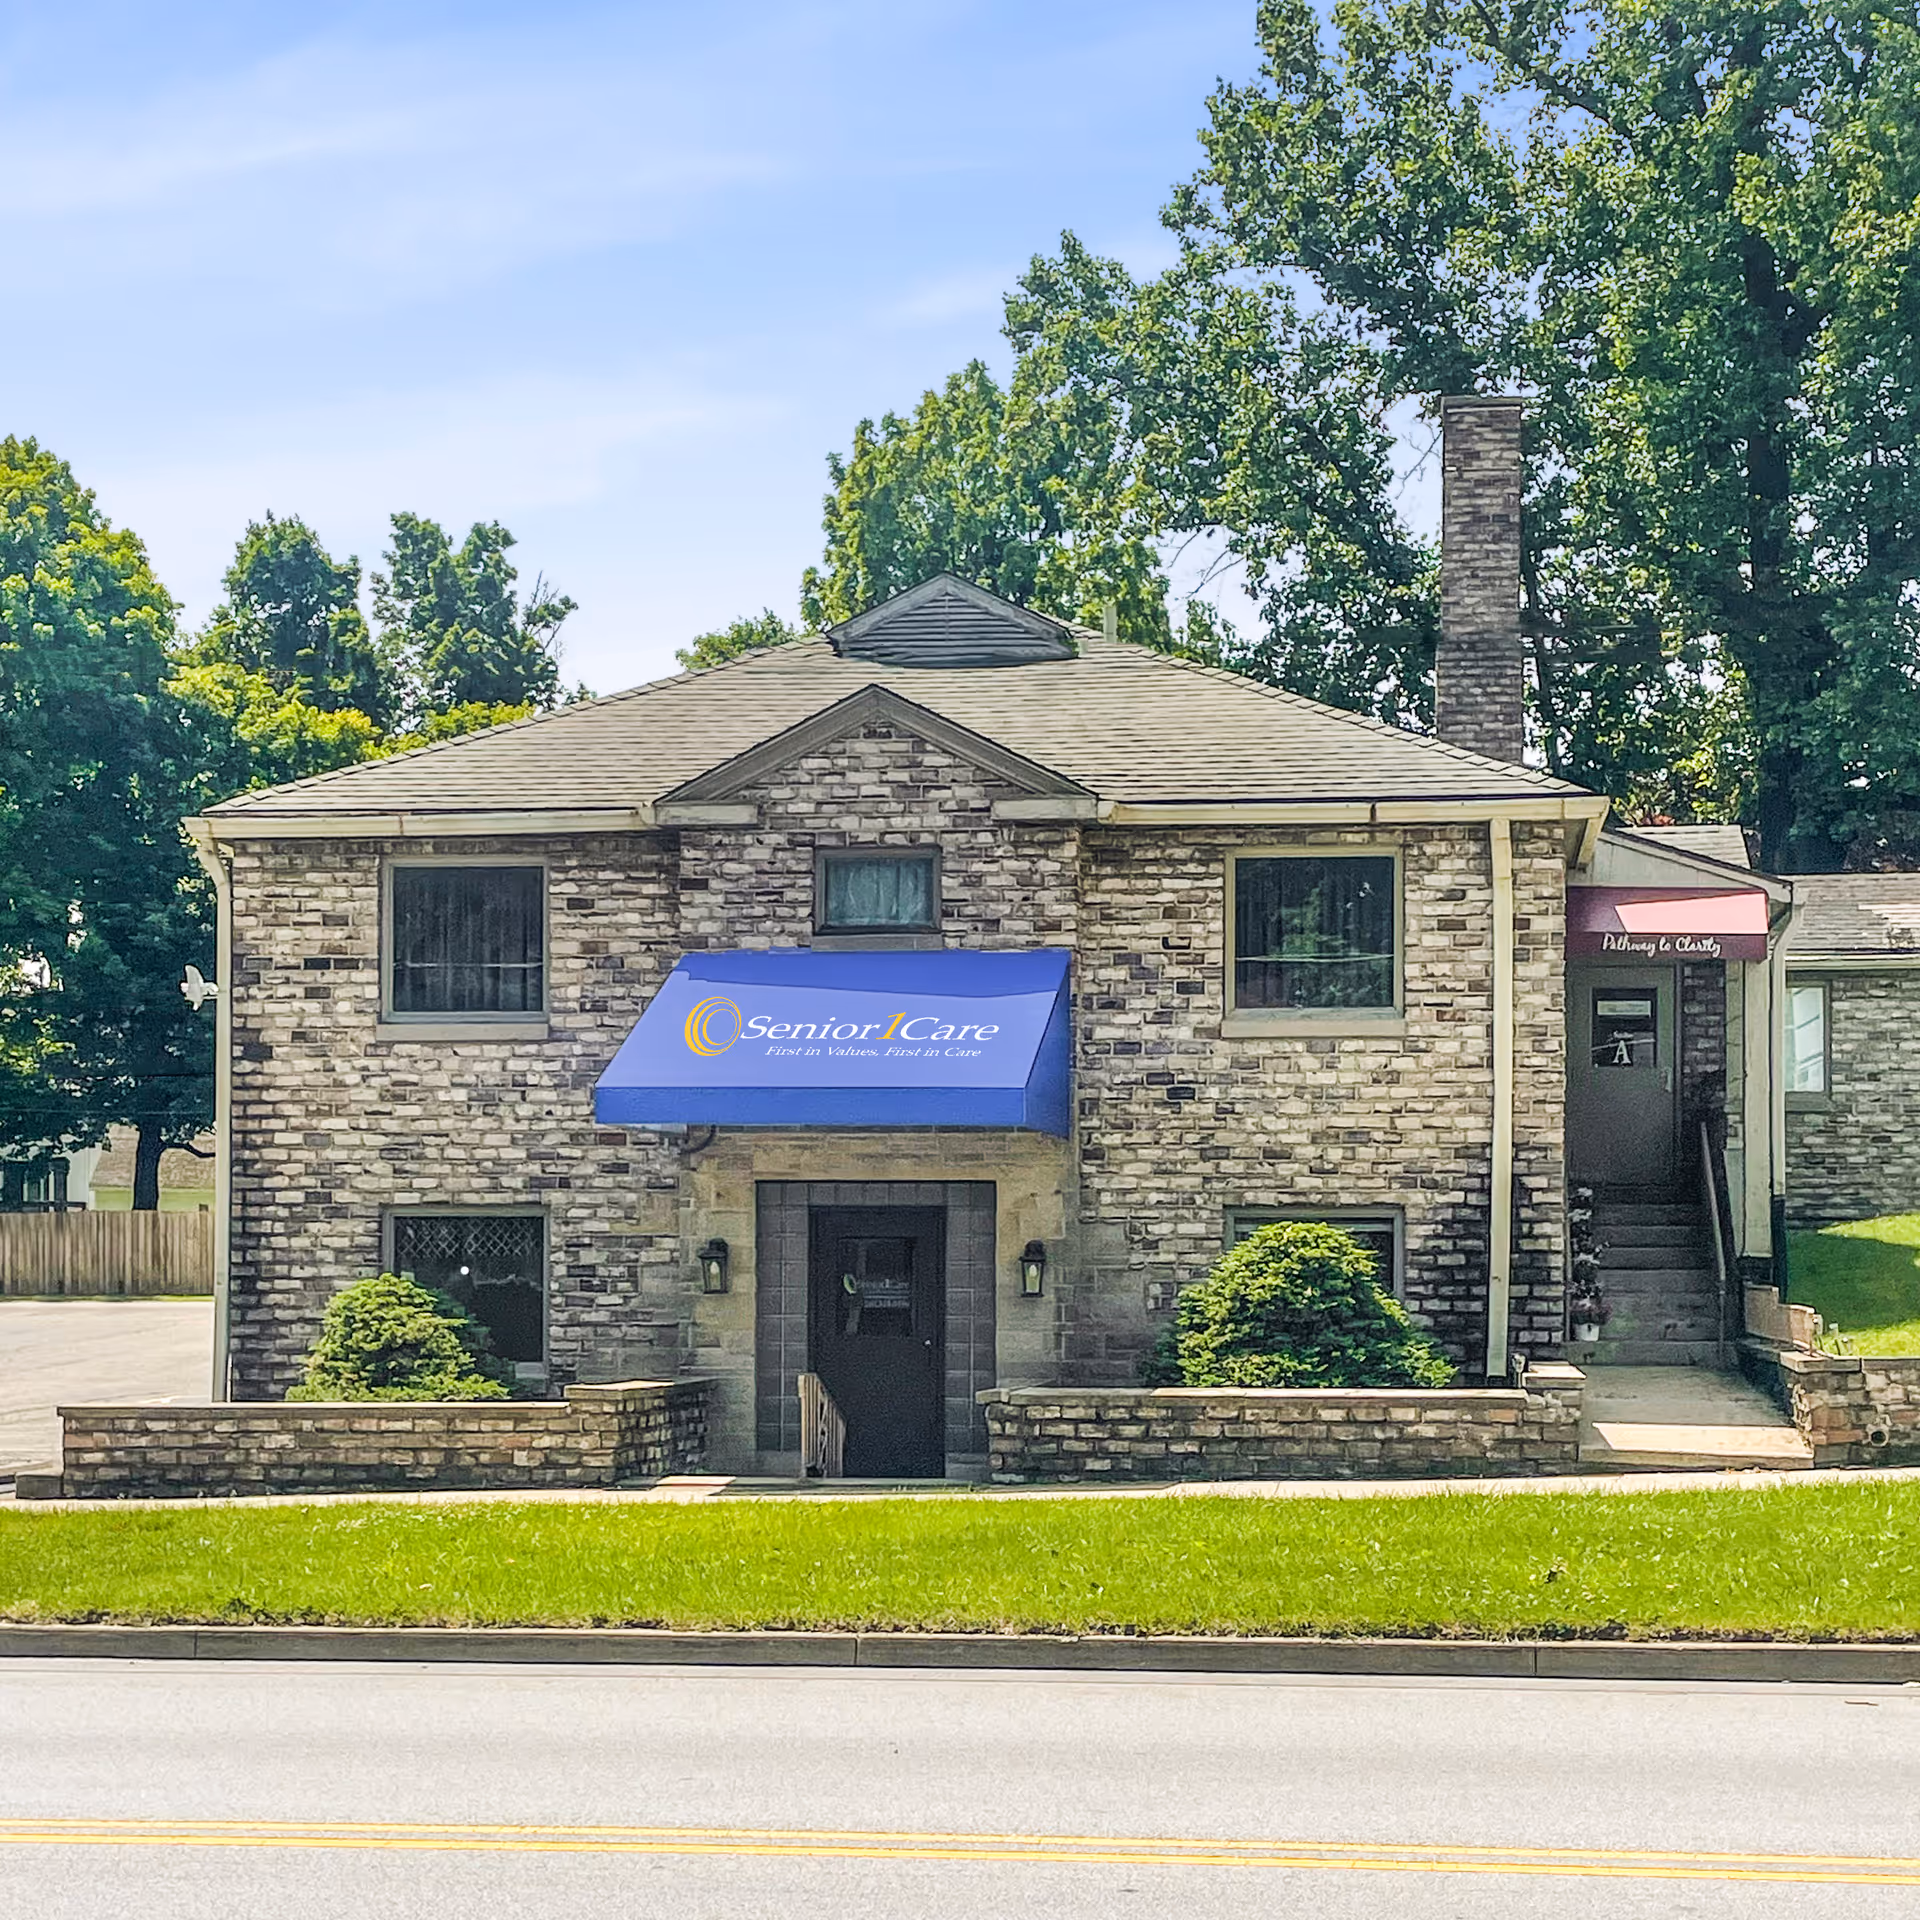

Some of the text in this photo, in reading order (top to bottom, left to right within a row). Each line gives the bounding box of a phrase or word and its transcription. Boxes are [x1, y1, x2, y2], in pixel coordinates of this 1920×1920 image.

[1602, 932, 1721, 958] Pathway to Clarity
[740, 1011, 1000, 1041] Senior1Care
[765, 1046, 982, 1057] First in Values, First in Care
[1612, 1039, 1632, 1064] A
